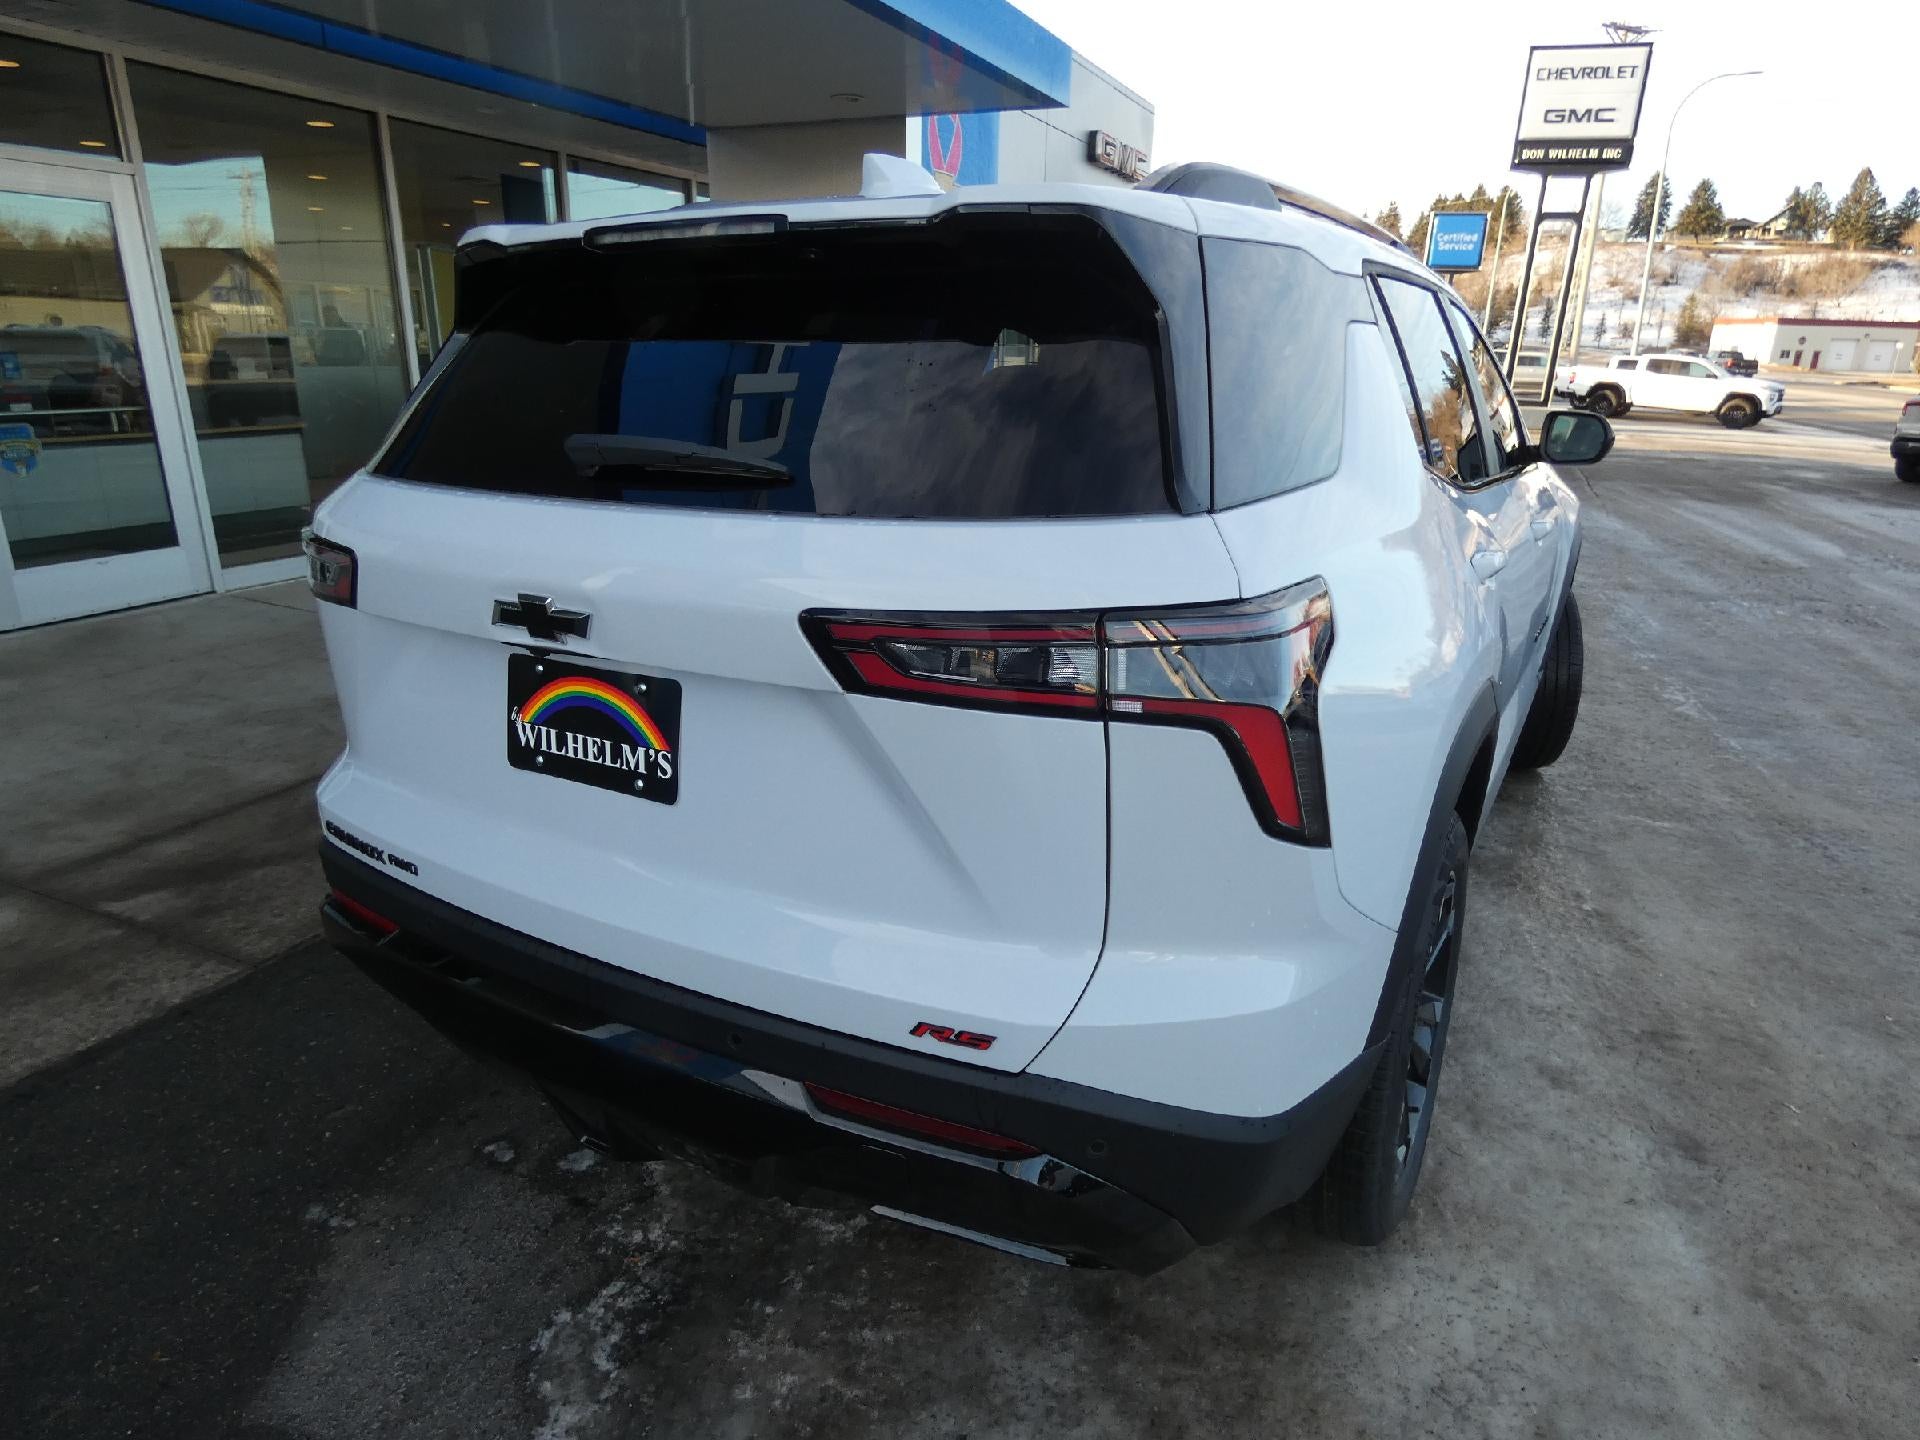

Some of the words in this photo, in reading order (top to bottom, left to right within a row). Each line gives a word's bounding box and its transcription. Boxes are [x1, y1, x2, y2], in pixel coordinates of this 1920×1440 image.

[1536, 65, 1639, 81] CHEVROLET
[1543, 107, 1617, 123] GMC
[1093, 129, 1149, 181] GMC
[1521, 148, 1545, 160] DON
[1548, 147, 1599, 160] WILHELM
[1602, 147, 1622, 159] INC
[1437, 232, 1478, 242] Certified
[1438, 241, 1475, 251] Service
[516, 722, 673, 779] WILHELM'S
[909, 1021, 998, 1050] RS
